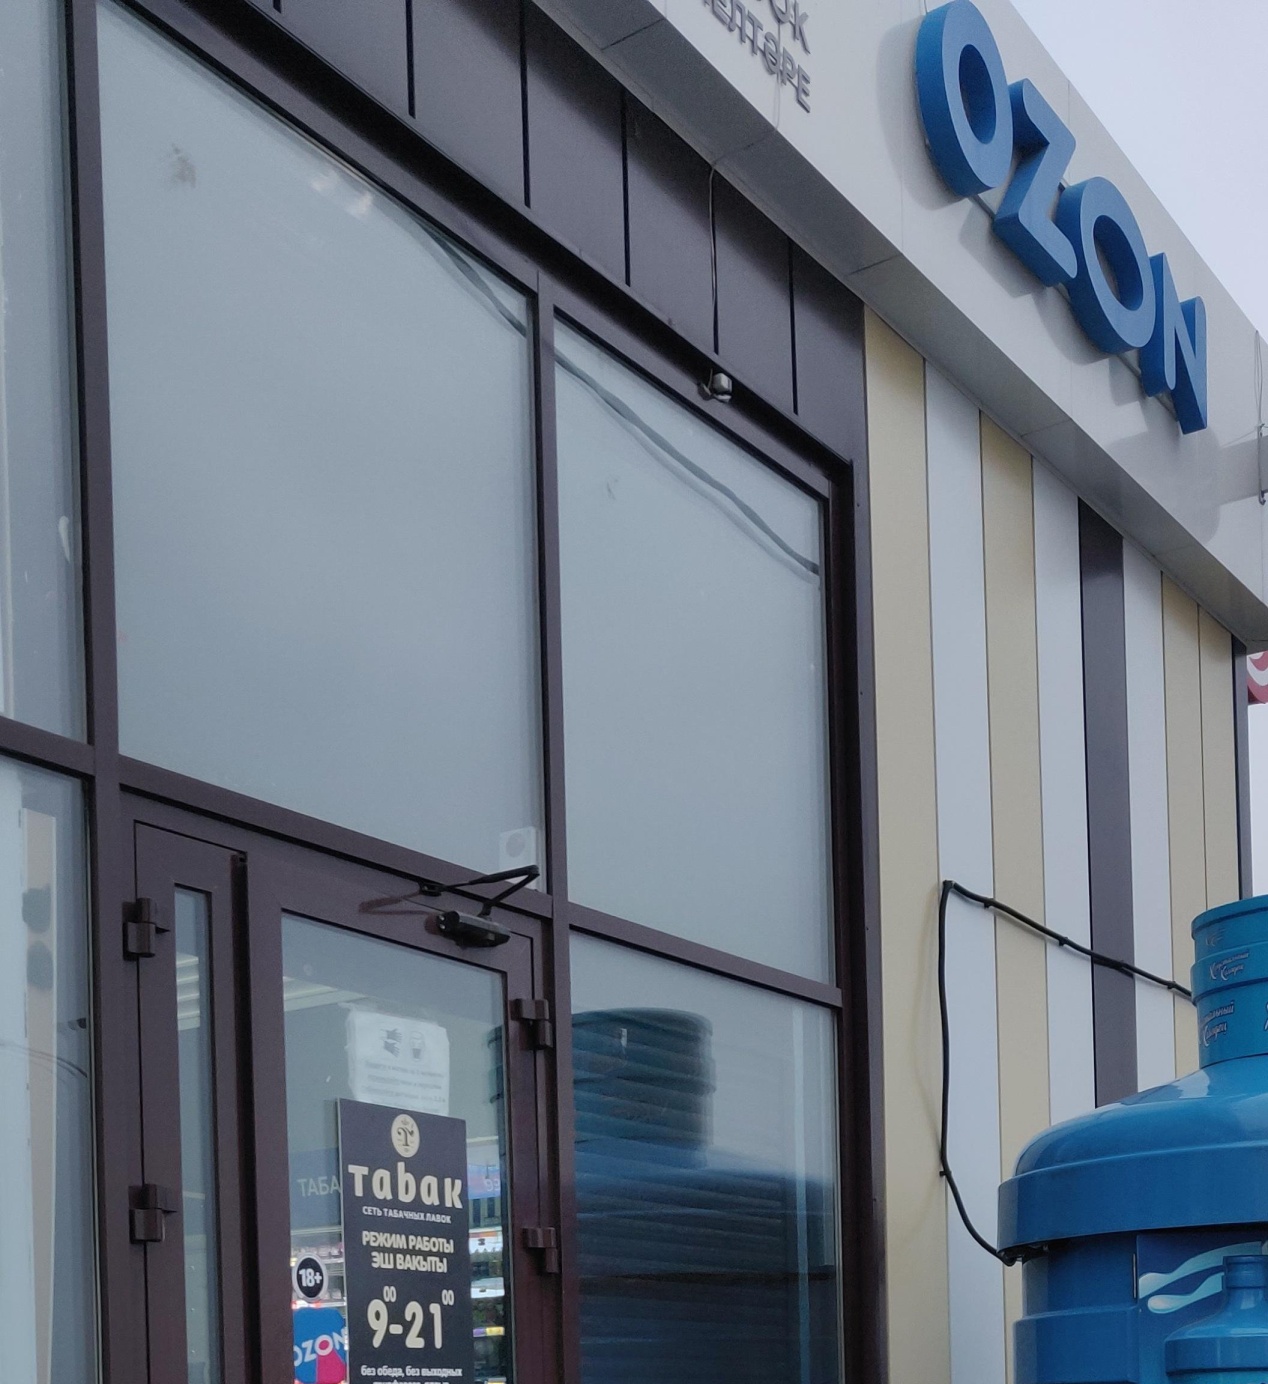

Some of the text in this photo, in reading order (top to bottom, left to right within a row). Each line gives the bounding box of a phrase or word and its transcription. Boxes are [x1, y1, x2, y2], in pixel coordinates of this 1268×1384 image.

[916, 0, 1207, 435] OZON
[298, 1175, 341, 1197] ТАБА
[362, 1206, 452, 1224] СЕТЬ ТАБАЧНЫХ ЛАВОК
[362, 1230, 454, 1254] РЕЖИМ РАБОТЫ
[371, 1251, 447, 1273] ЭШ ВАКЫТЫ
[299, 1268, 322, 1287] 18+
[361, 1365, 463, 1378] без обеда, без выходных
